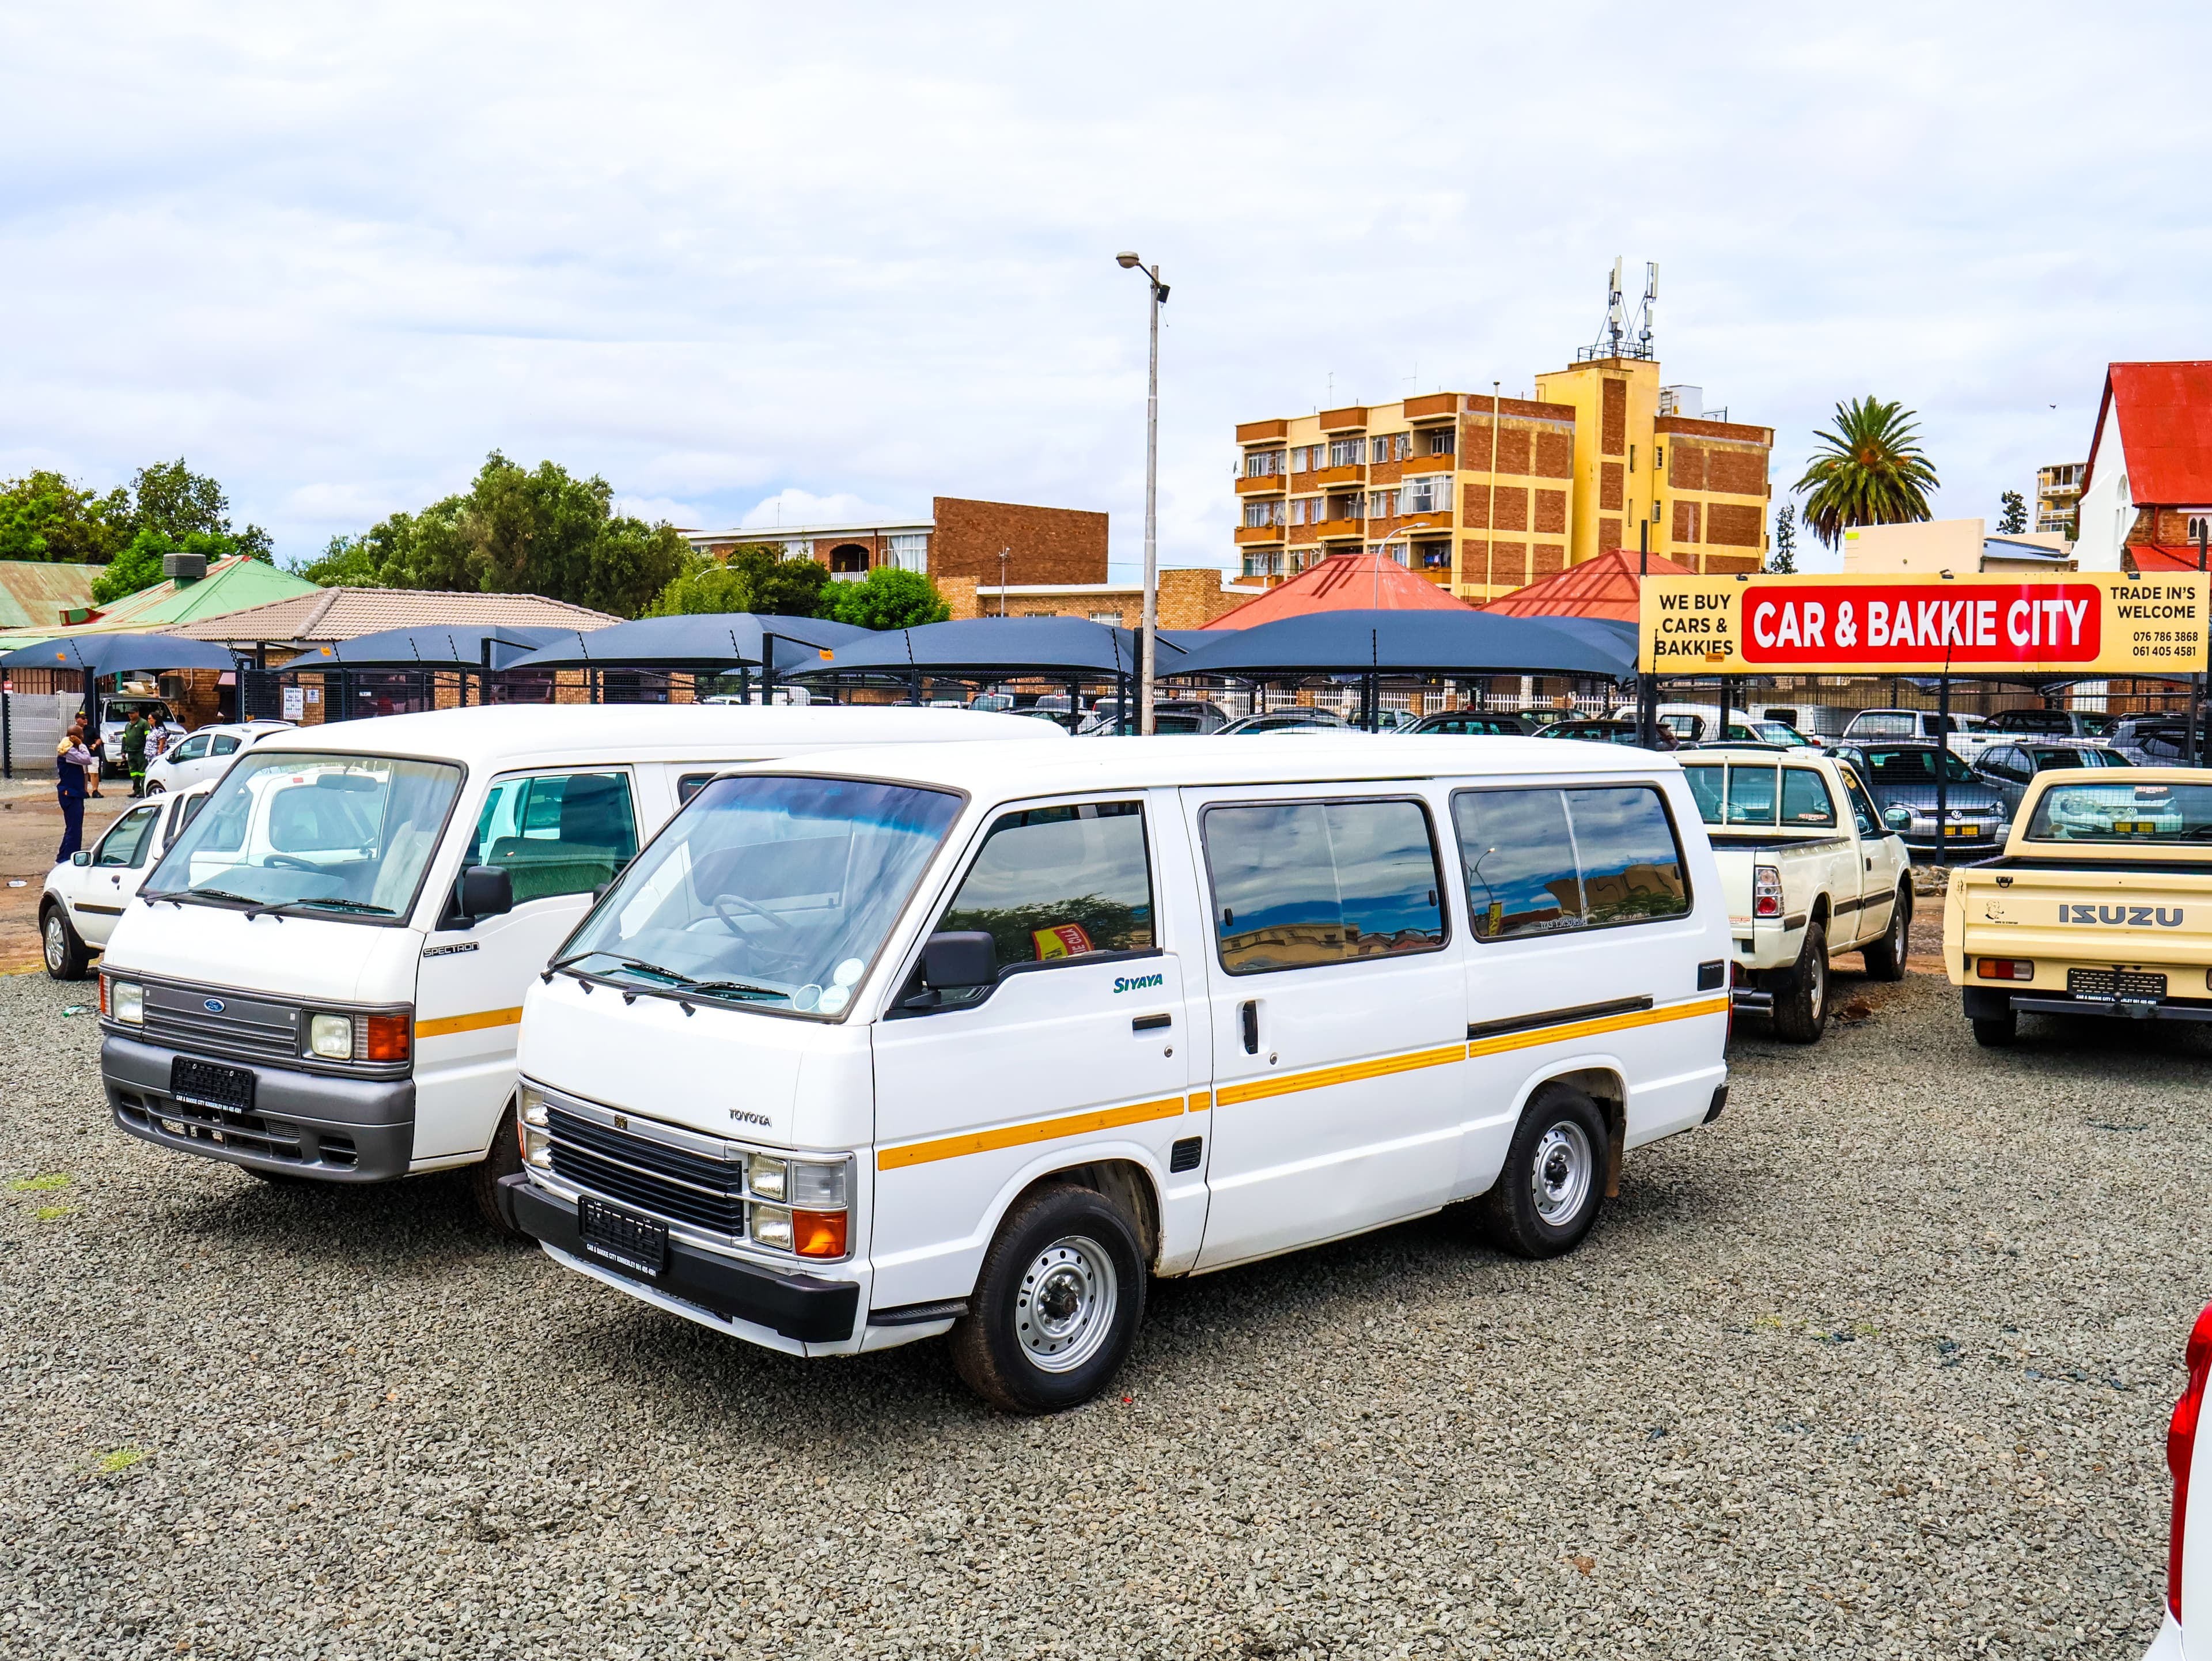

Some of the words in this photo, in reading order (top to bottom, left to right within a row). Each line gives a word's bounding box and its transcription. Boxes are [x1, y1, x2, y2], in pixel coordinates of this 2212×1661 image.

[2111, 587, 2161, 600] TRADE
[2166, 587, 2195, 600] IN'S
[1659, 595, 1688, 610] WE
[1695, 595, 1732, 610] BUY
[2118, 606, 2195, 618] WELCOME
[1662, 618, 1710, 633] CARS
[1716, 618, 1728, 633] &
[1753, 601, 1825, 648] CAR
[1835, 600, 1858, 648] &
[1868, 600, 1997, 646] BAKKIE
[2007, 599, 2089, 646] CITY
[2133, 631, 2152, 642] 076
[2154, 631, 2172, 642] 786
[2175, 631, 2198, 642] 3868
[1655, 640, 1733, 656] BAKKIES
[2133, 646, 2149, 656] 061
[2152, 646, 2171, 656] 405
[2174, 646, 2196, 656] 4581
[2059, 904, 2183, 927] ISUZU
[423, 943, 479, 956] SPECTRON
[729, 1108, 772, 1127] TOYOTA
